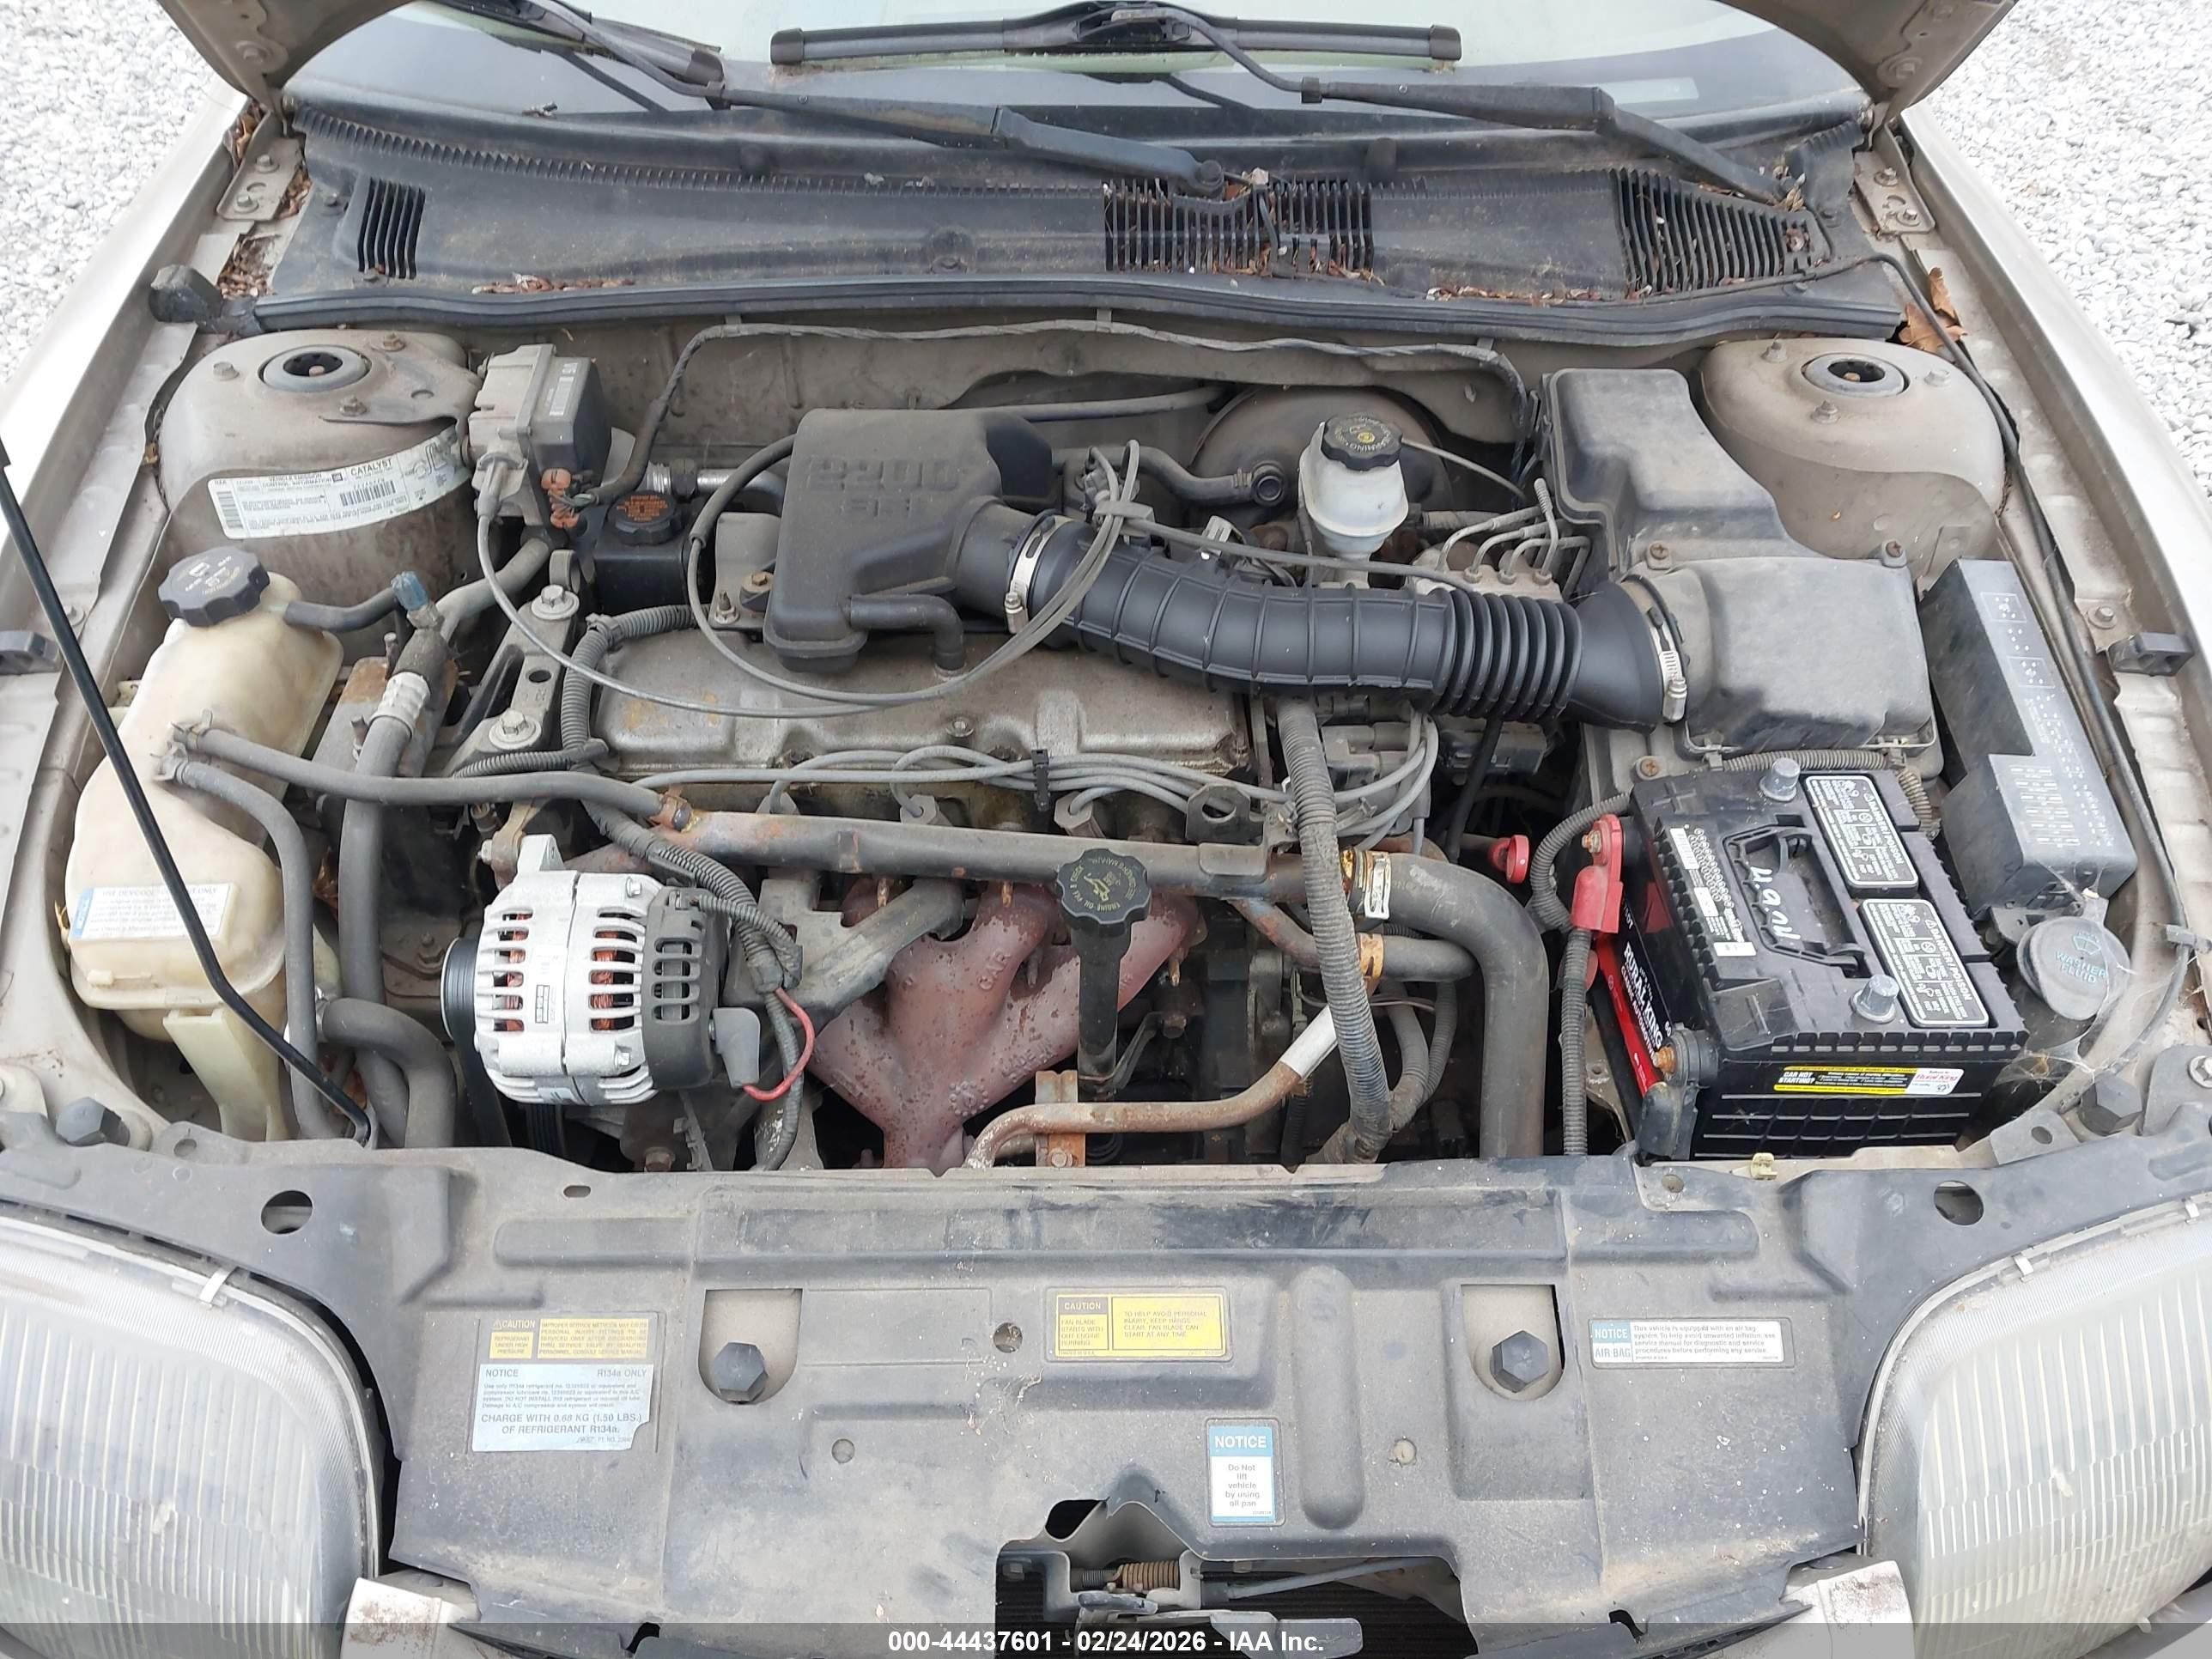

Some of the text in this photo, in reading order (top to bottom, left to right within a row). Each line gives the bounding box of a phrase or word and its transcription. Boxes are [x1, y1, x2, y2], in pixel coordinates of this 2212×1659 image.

[351, 459, 392, 475] CATALYST
[2056, 951, 2107, 977] WASHER
[2061, 963, 2096, 983] FLUID
[1623, 941, 1663, 1048] RURAL KING
[1064, 1302, 1101, 1310] CAUTION
[502, 1320, 535, 1328] CAUTION
[1595, 1328, 1627, 1339] NOTICE
[1595, 1347, 1611, 1358] AIR
[1613, 1347, 1631, 1358] BAG
[485, 1369, 519, 1377] NOTICE
[598, 1369, 647, 1377] R134a ONLY
[481, 1413, 522, 1423] CHARGE
[526, 1414, 550, 1423] WITH
[501, 1425, 514, 1434] OF
[518, 1425, 586, 1434] REFRIGERANT
[1215, 1436, 1267, 1449] NOTICE
